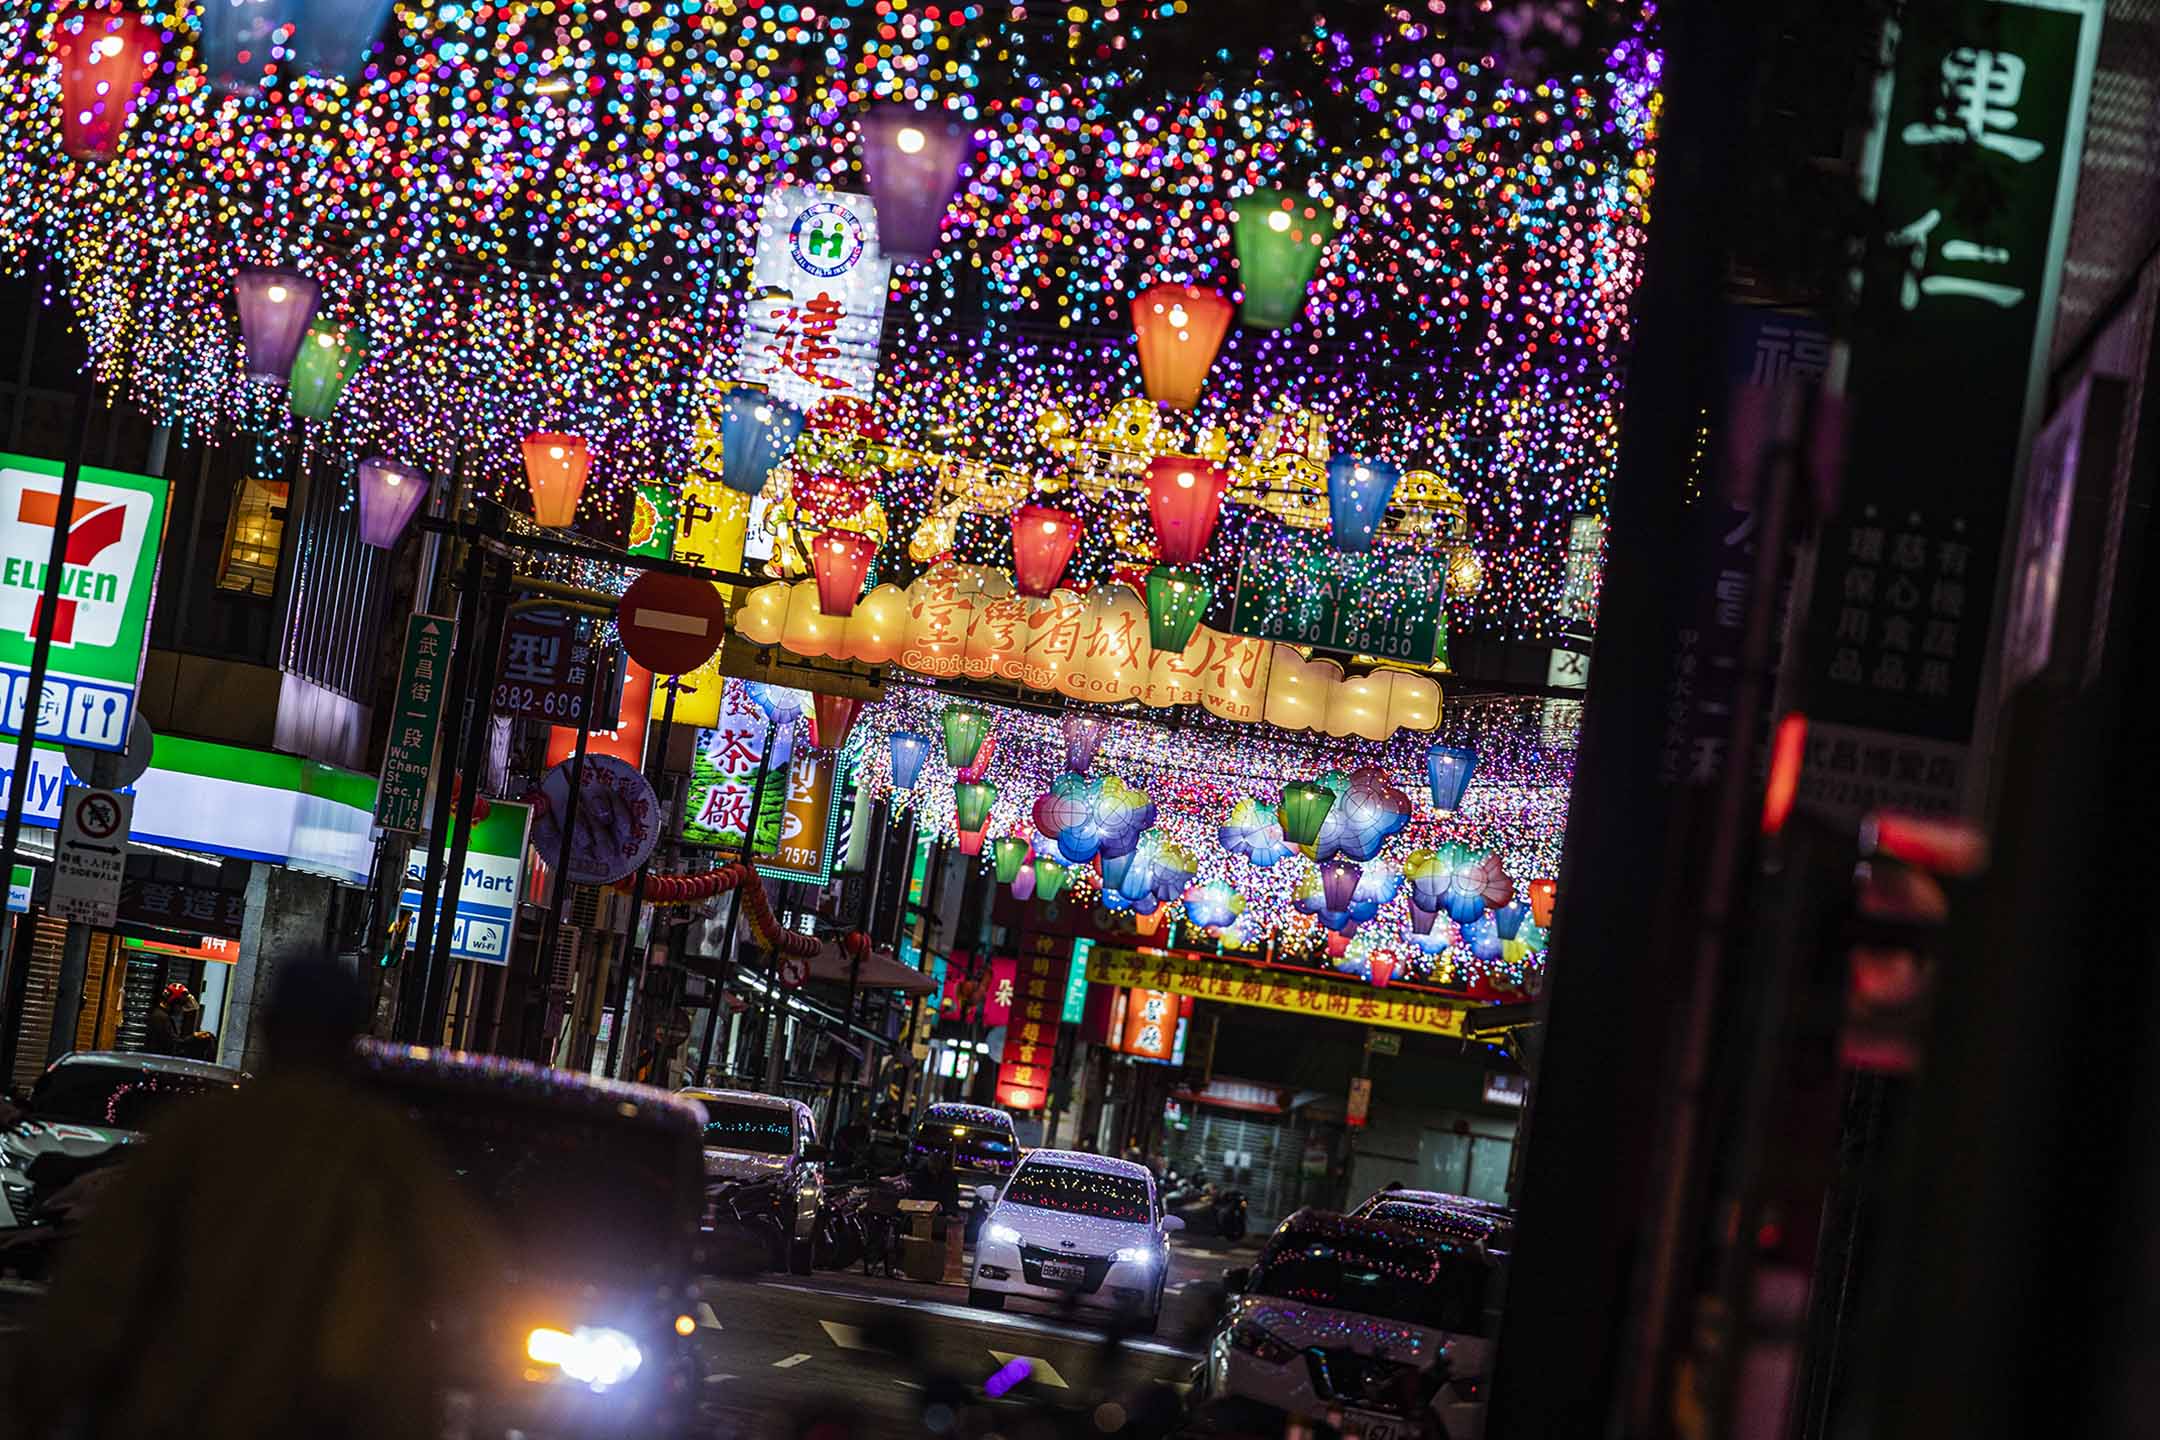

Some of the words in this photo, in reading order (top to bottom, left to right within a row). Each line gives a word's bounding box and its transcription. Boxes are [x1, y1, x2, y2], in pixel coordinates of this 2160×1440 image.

[17, 488, 127, 644] 7
[402, 636, 438, 748] 武昌街一段
[902, 649, 995, 675] Capital
[1003, 660, 1057, 687] City
[1067, 673, 1120, 695] God
[1131, 683, 1156, 701] of
[1166, 685, 1251, 718] Taiwan
[390, 746, 409, 760] Wu
[387, 759, 428, 778] Chang
[384, 783, 411, 798] Sec.
[407, 799, 419, 812] 18
[382, 813, 393, 826] 41
[403, 816, 417, 830] 42
[1092, 955, 1462, 1032] 臺灣省城隍廟慶祝開基140週
